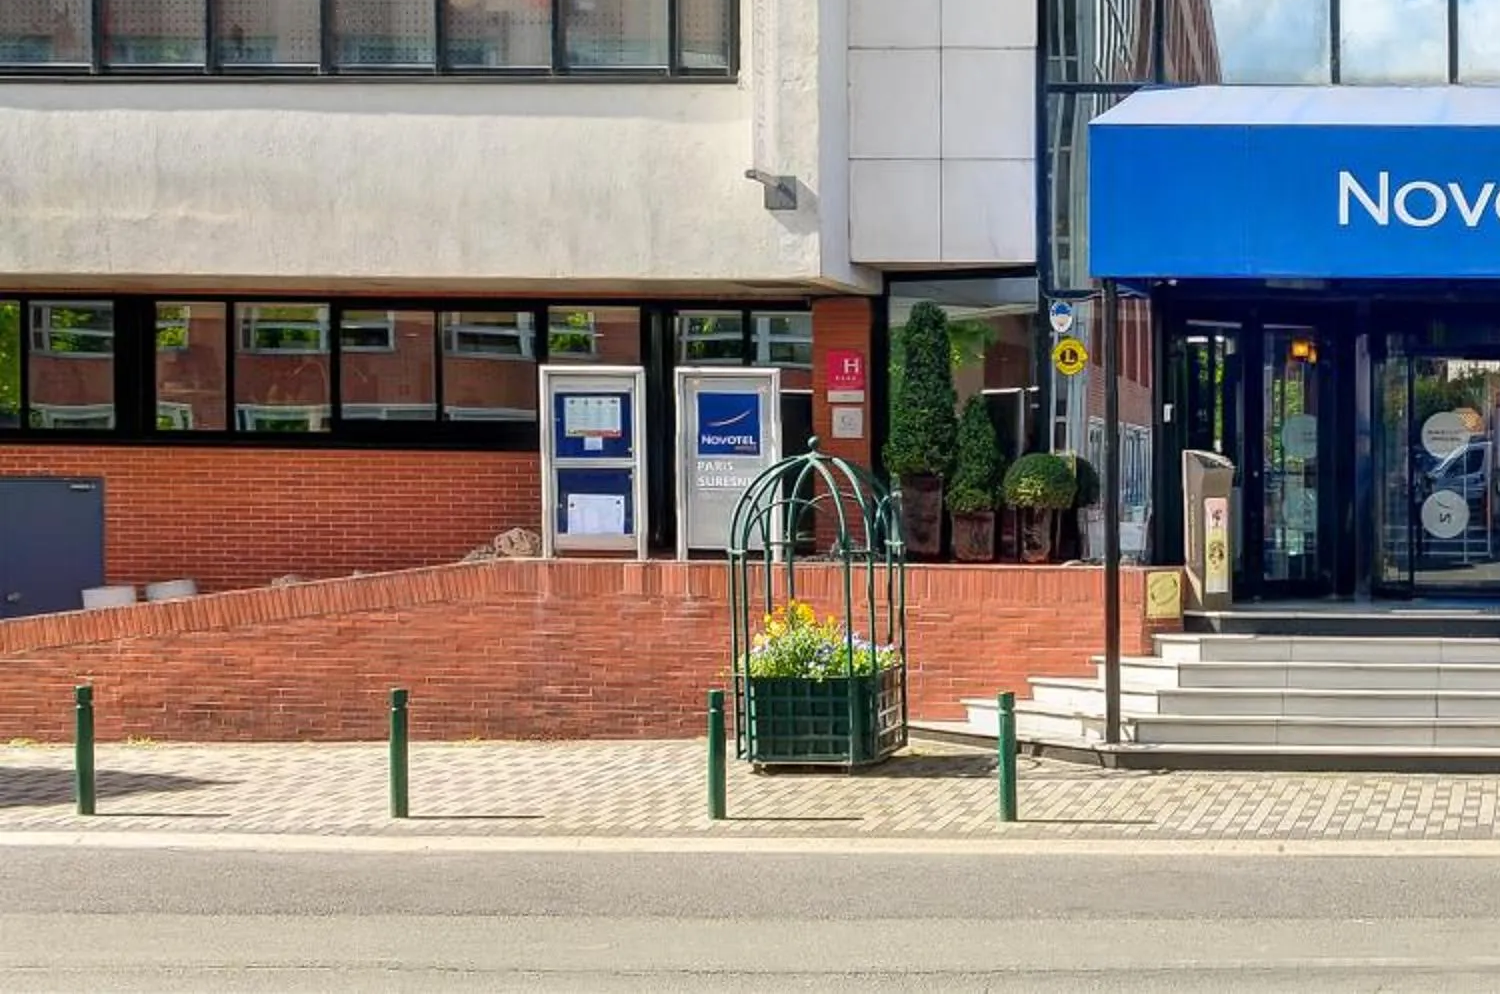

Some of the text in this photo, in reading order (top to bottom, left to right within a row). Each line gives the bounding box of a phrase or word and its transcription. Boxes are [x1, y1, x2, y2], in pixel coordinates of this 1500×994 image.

[843, 357, 860, 374] H
[701, 435, 757, 445] NOVOTEL
[697, 461, 733, 471] PARIS
